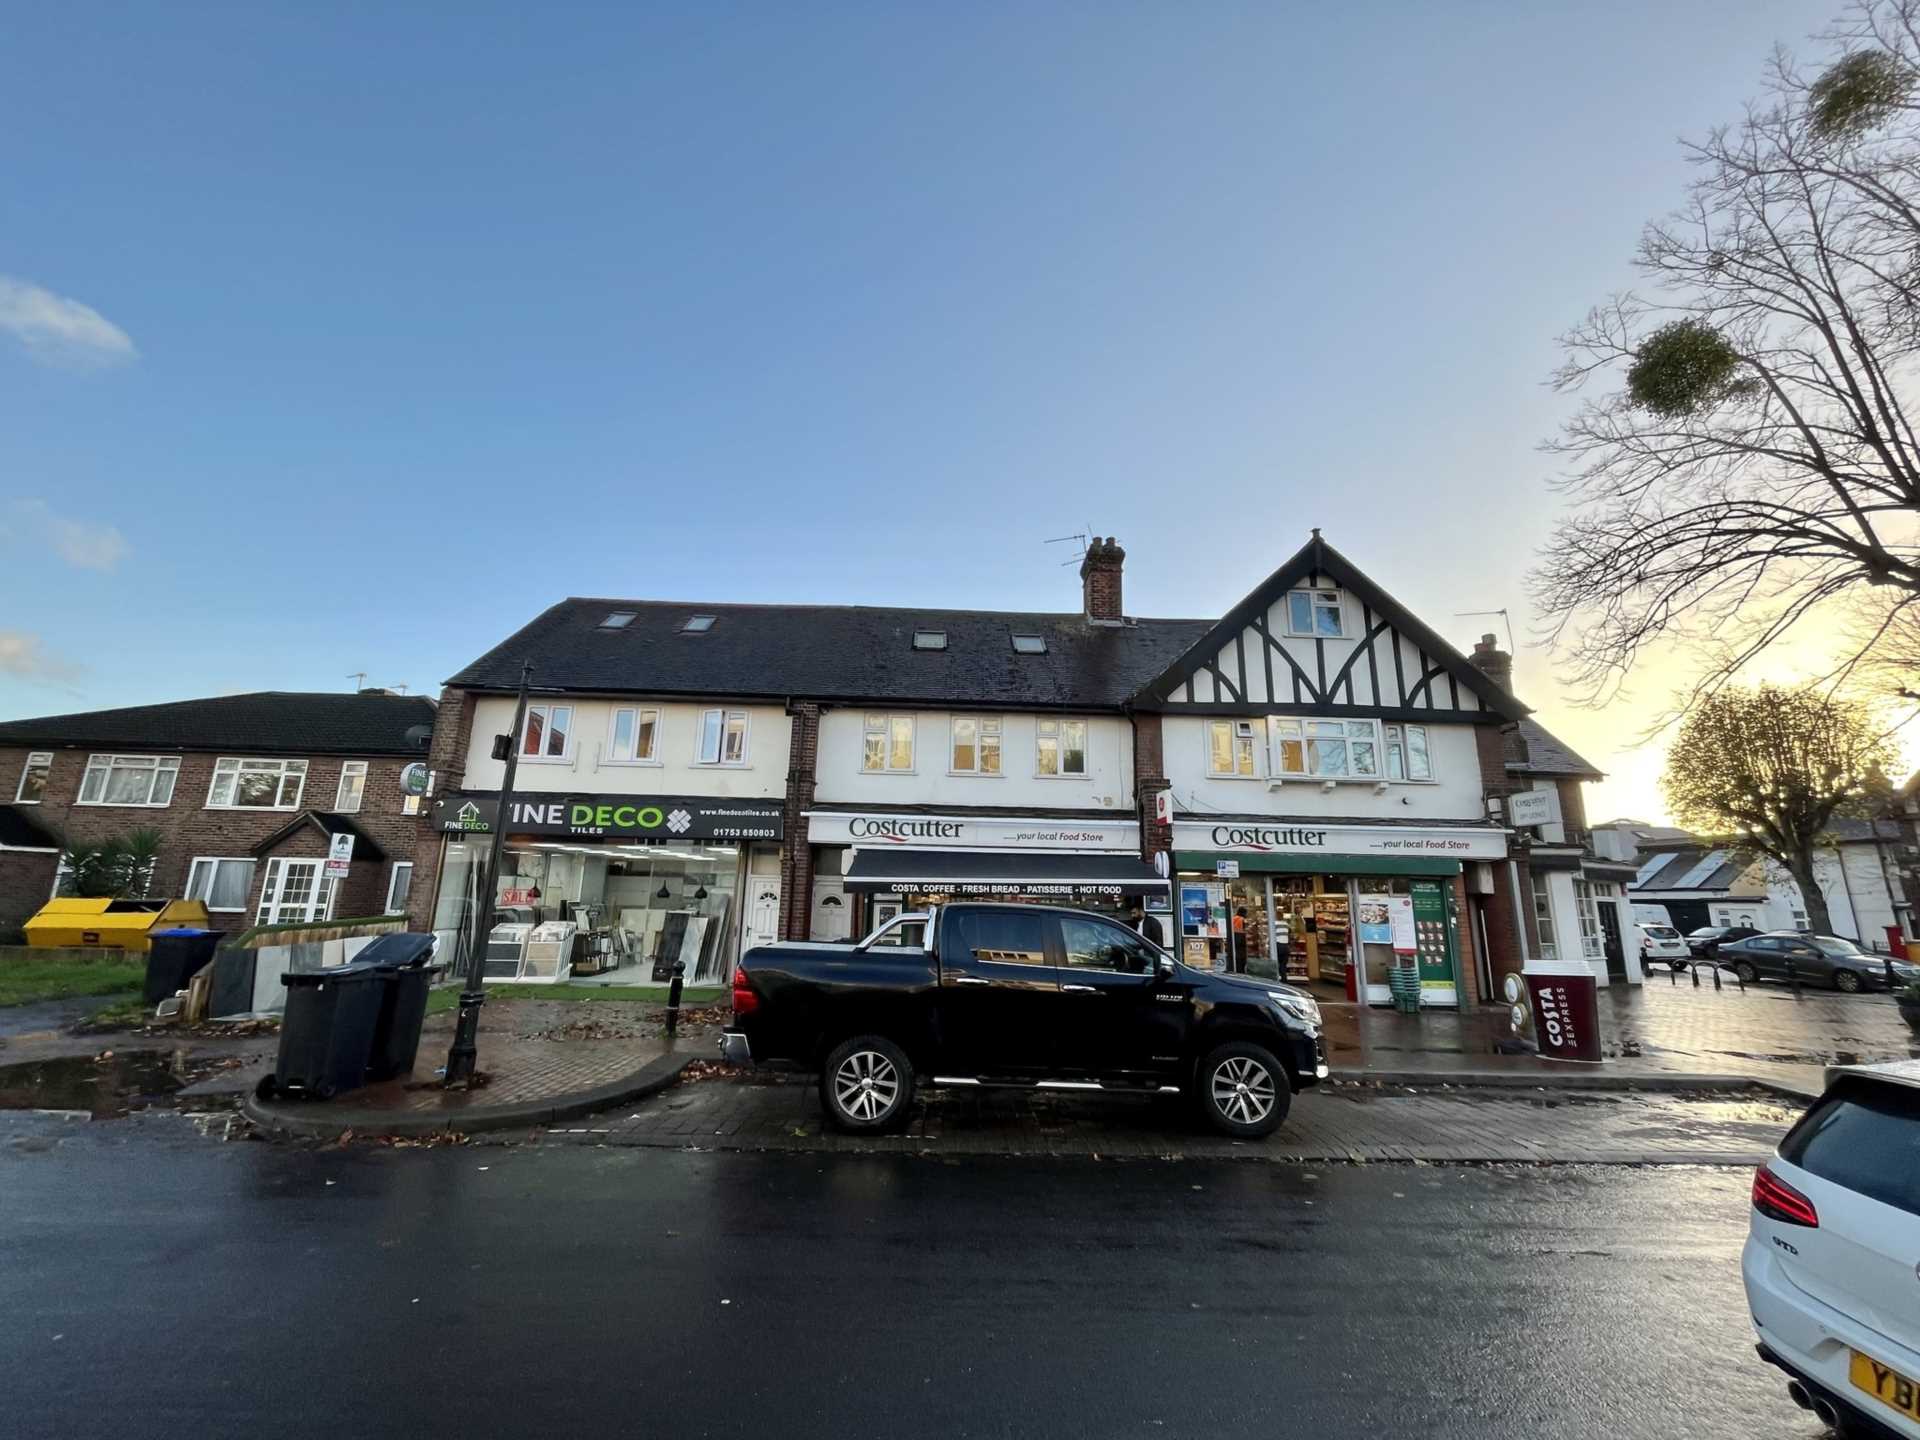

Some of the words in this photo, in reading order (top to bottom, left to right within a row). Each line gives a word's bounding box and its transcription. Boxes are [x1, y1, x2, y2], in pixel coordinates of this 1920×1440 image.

[411, 768, 426, 777] FINE
[509, 803, 565, 825] INE
[571, 805, 663, 828] DECO
[444, 820, 463, 830] FINE
[464, 821, 489, 830] DECO
[713, 828, 740, 836] 01753
[742, 828, 775, 837] 650803
[849, 817, 964, 838] Costcutter
[1037, 832, 1057, 841] local
[1059, 832, 1080, 841] Food
[1081, 832, 1104, 842] Store
[1212, 826, 1327, 846] Costcutter
[1403, 839, 1423, 848] local
[1425, 840, 1446, 849] Food
[1447, 840, 1470, 850] Store
[891, 884, 919, 893] COSTA
[922, 884, 955, 893] COFFEE
[962, 885, 990, 893] FRESH
[991, 885, 1020, 894] BREAD
[1027, 885, 1073, 894] PATISSERIE
[1080, 886, 1097, 894] HOT
[1099, 886, 1122, 894] FOOD
[1189, 942, 1205, 950] 107
[1538, 987, 1563, 1047] COSTA
[1556, 987, 1575, 1038] EXPRESS
[1772, 1235, 1798, 1256] GTD
[1871, 1362, 1920, 1420] YB
